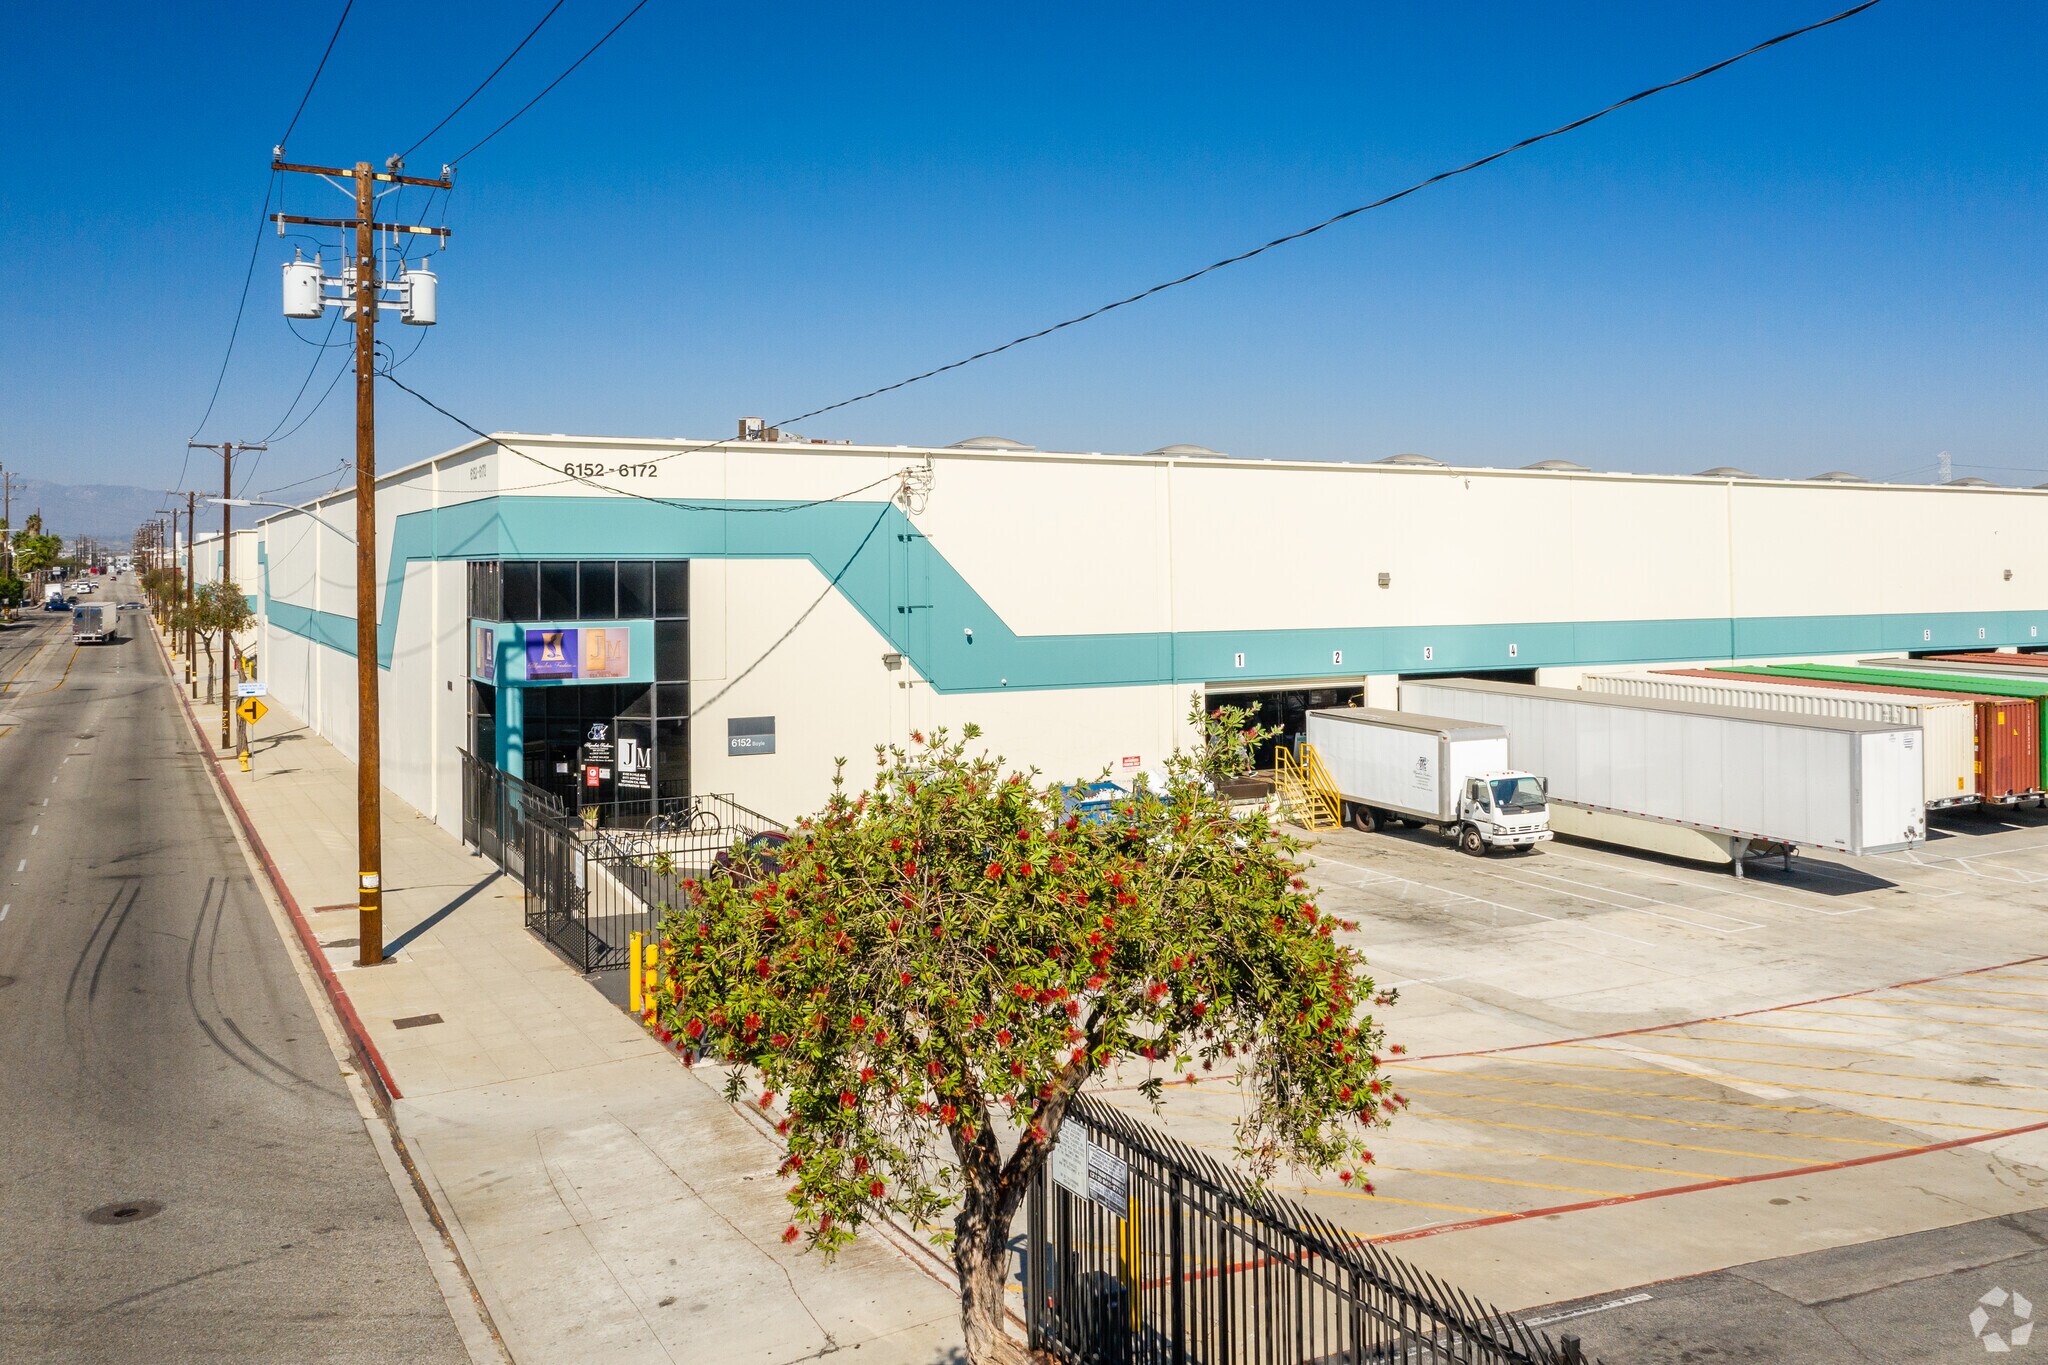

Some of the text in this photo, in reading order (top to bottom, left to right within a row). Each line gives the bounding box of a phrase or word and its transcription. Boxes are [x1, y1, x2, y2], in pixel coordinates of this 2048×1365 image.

[564, 463, 604, 477] 6152
[619, 464, 657, 477] 6172
[731, 738, 751, 747] 6152
